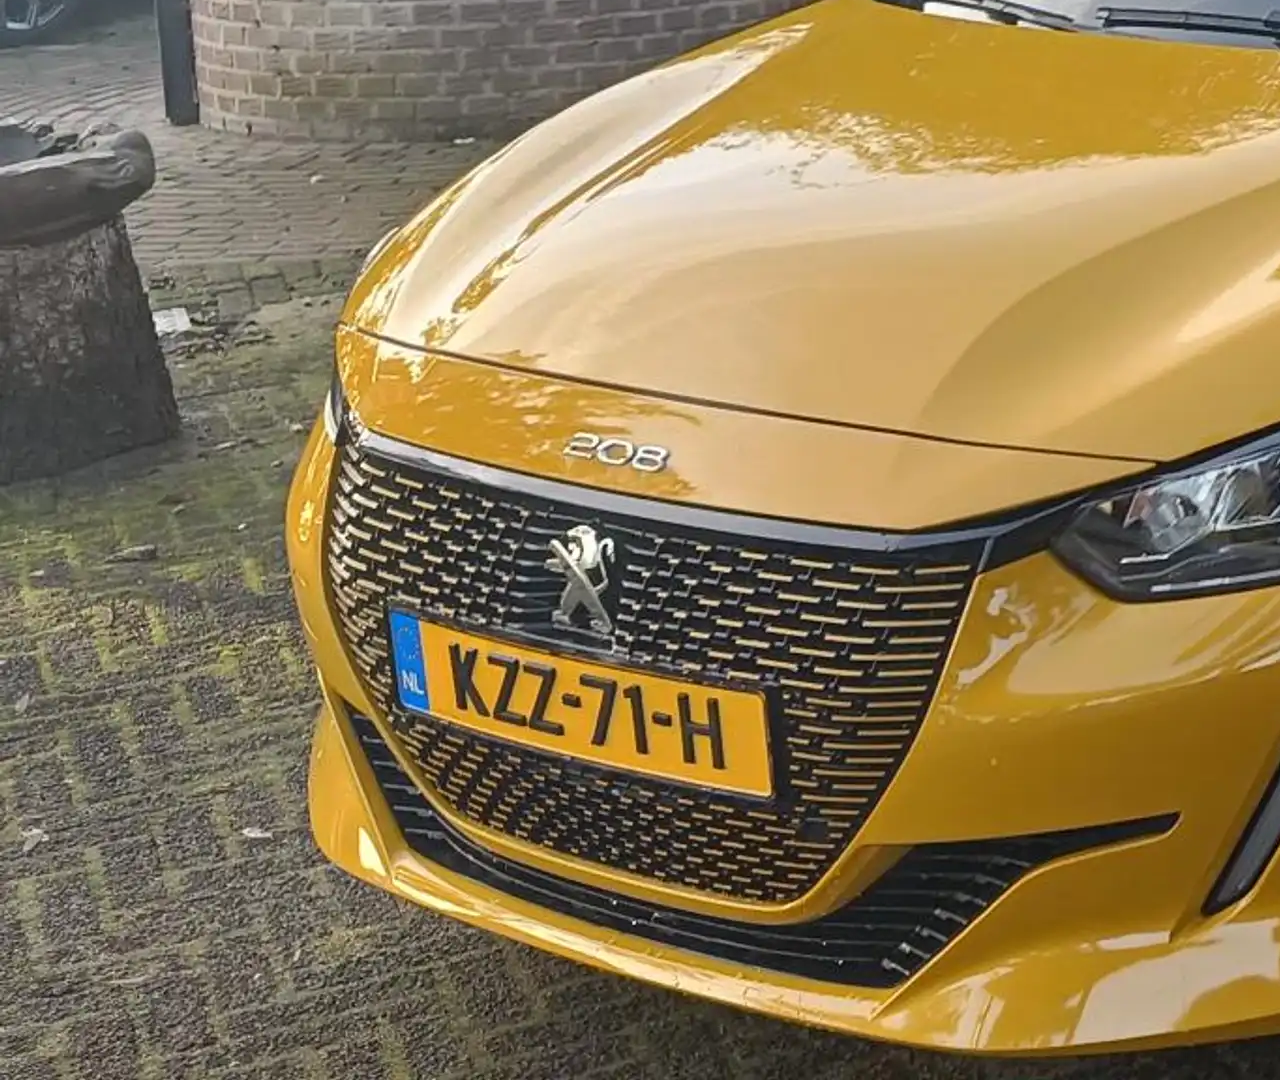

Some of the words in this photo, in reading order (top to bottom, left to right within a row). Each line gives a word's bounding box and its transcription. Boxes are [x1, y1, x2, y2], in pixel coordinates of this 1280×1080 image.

[563, 432, 669, 472] 208
[402, 672, 424, 695] NL
[449, 642, 726, 770] KZZ-71-H
